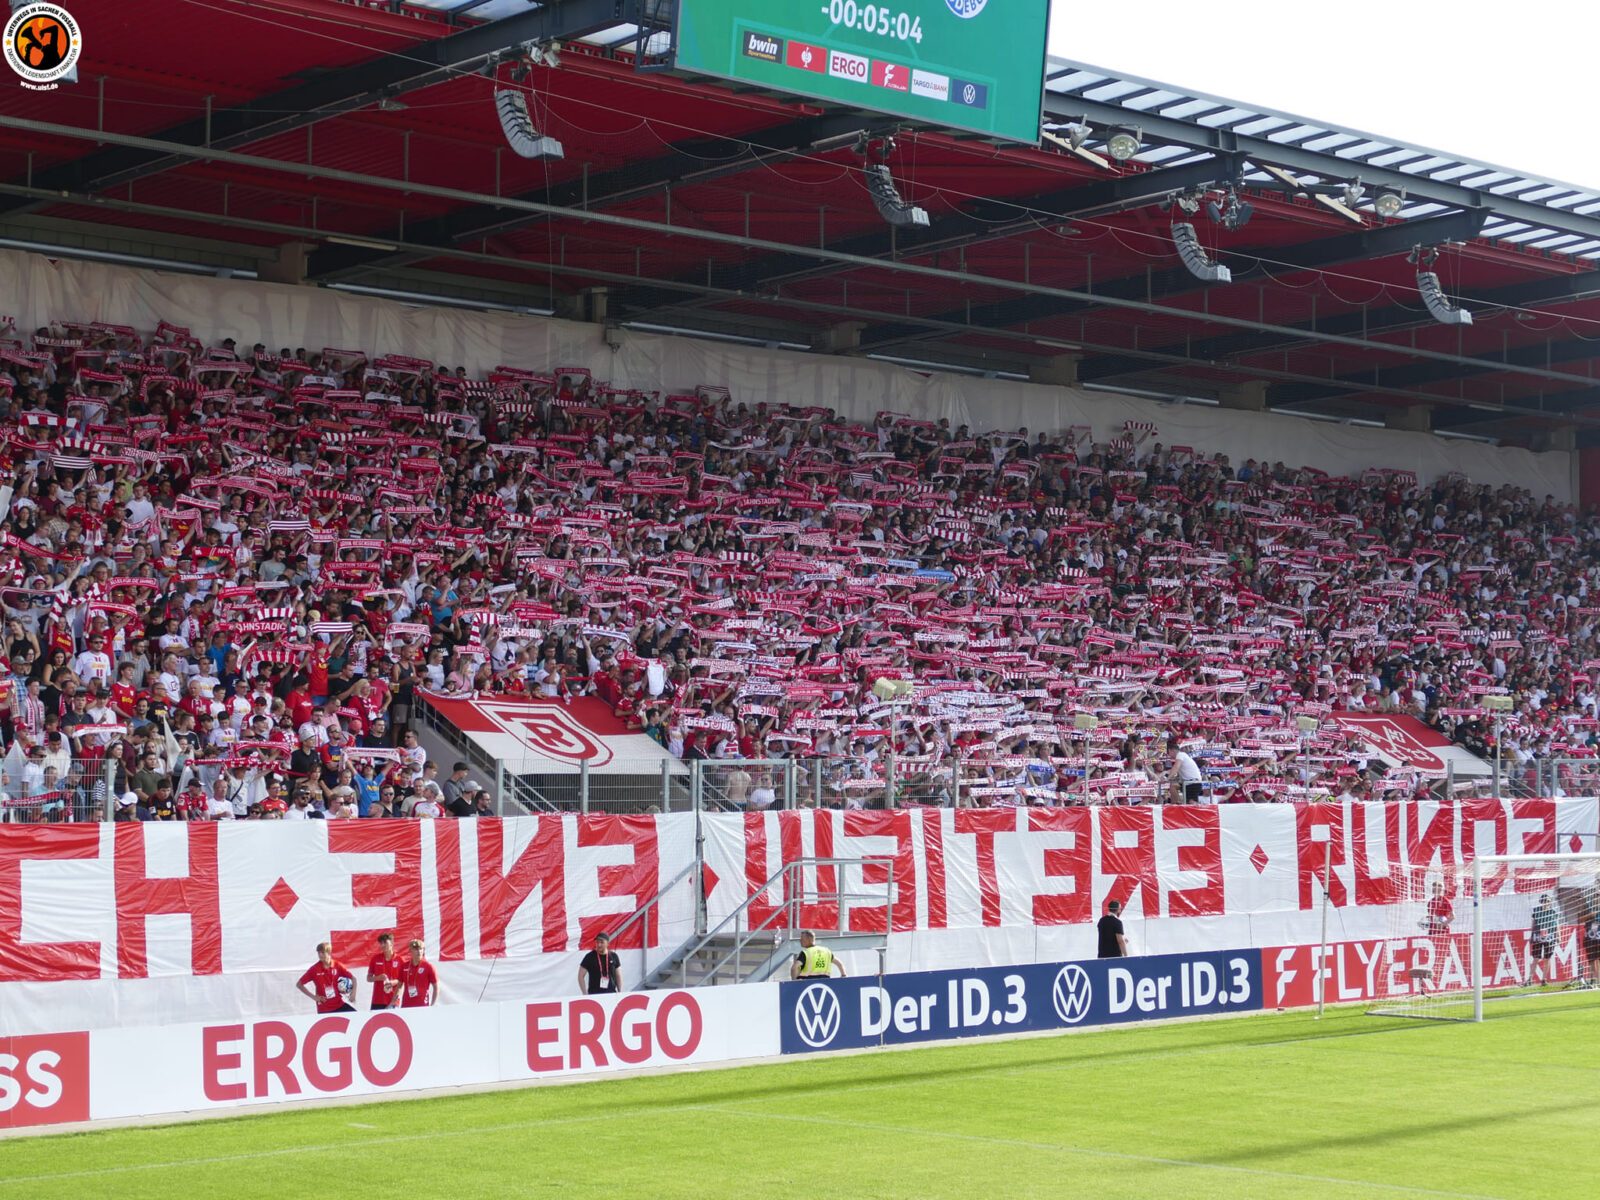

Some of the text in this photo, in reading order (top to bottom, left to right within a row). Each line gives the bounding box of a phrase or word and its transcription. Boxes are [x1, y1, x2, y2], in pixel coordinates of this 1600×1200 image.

[748, 34, 778, 55] bwin
[832, 56, 866, 77] ERGO
[860, 974, 1027, 1037] Der ID.3
[1108, 957, 1251, 1015] Der ID.3
[202, 1012, 414, 1103] ERGO
[525, 991, 703, 1073] ERGO
